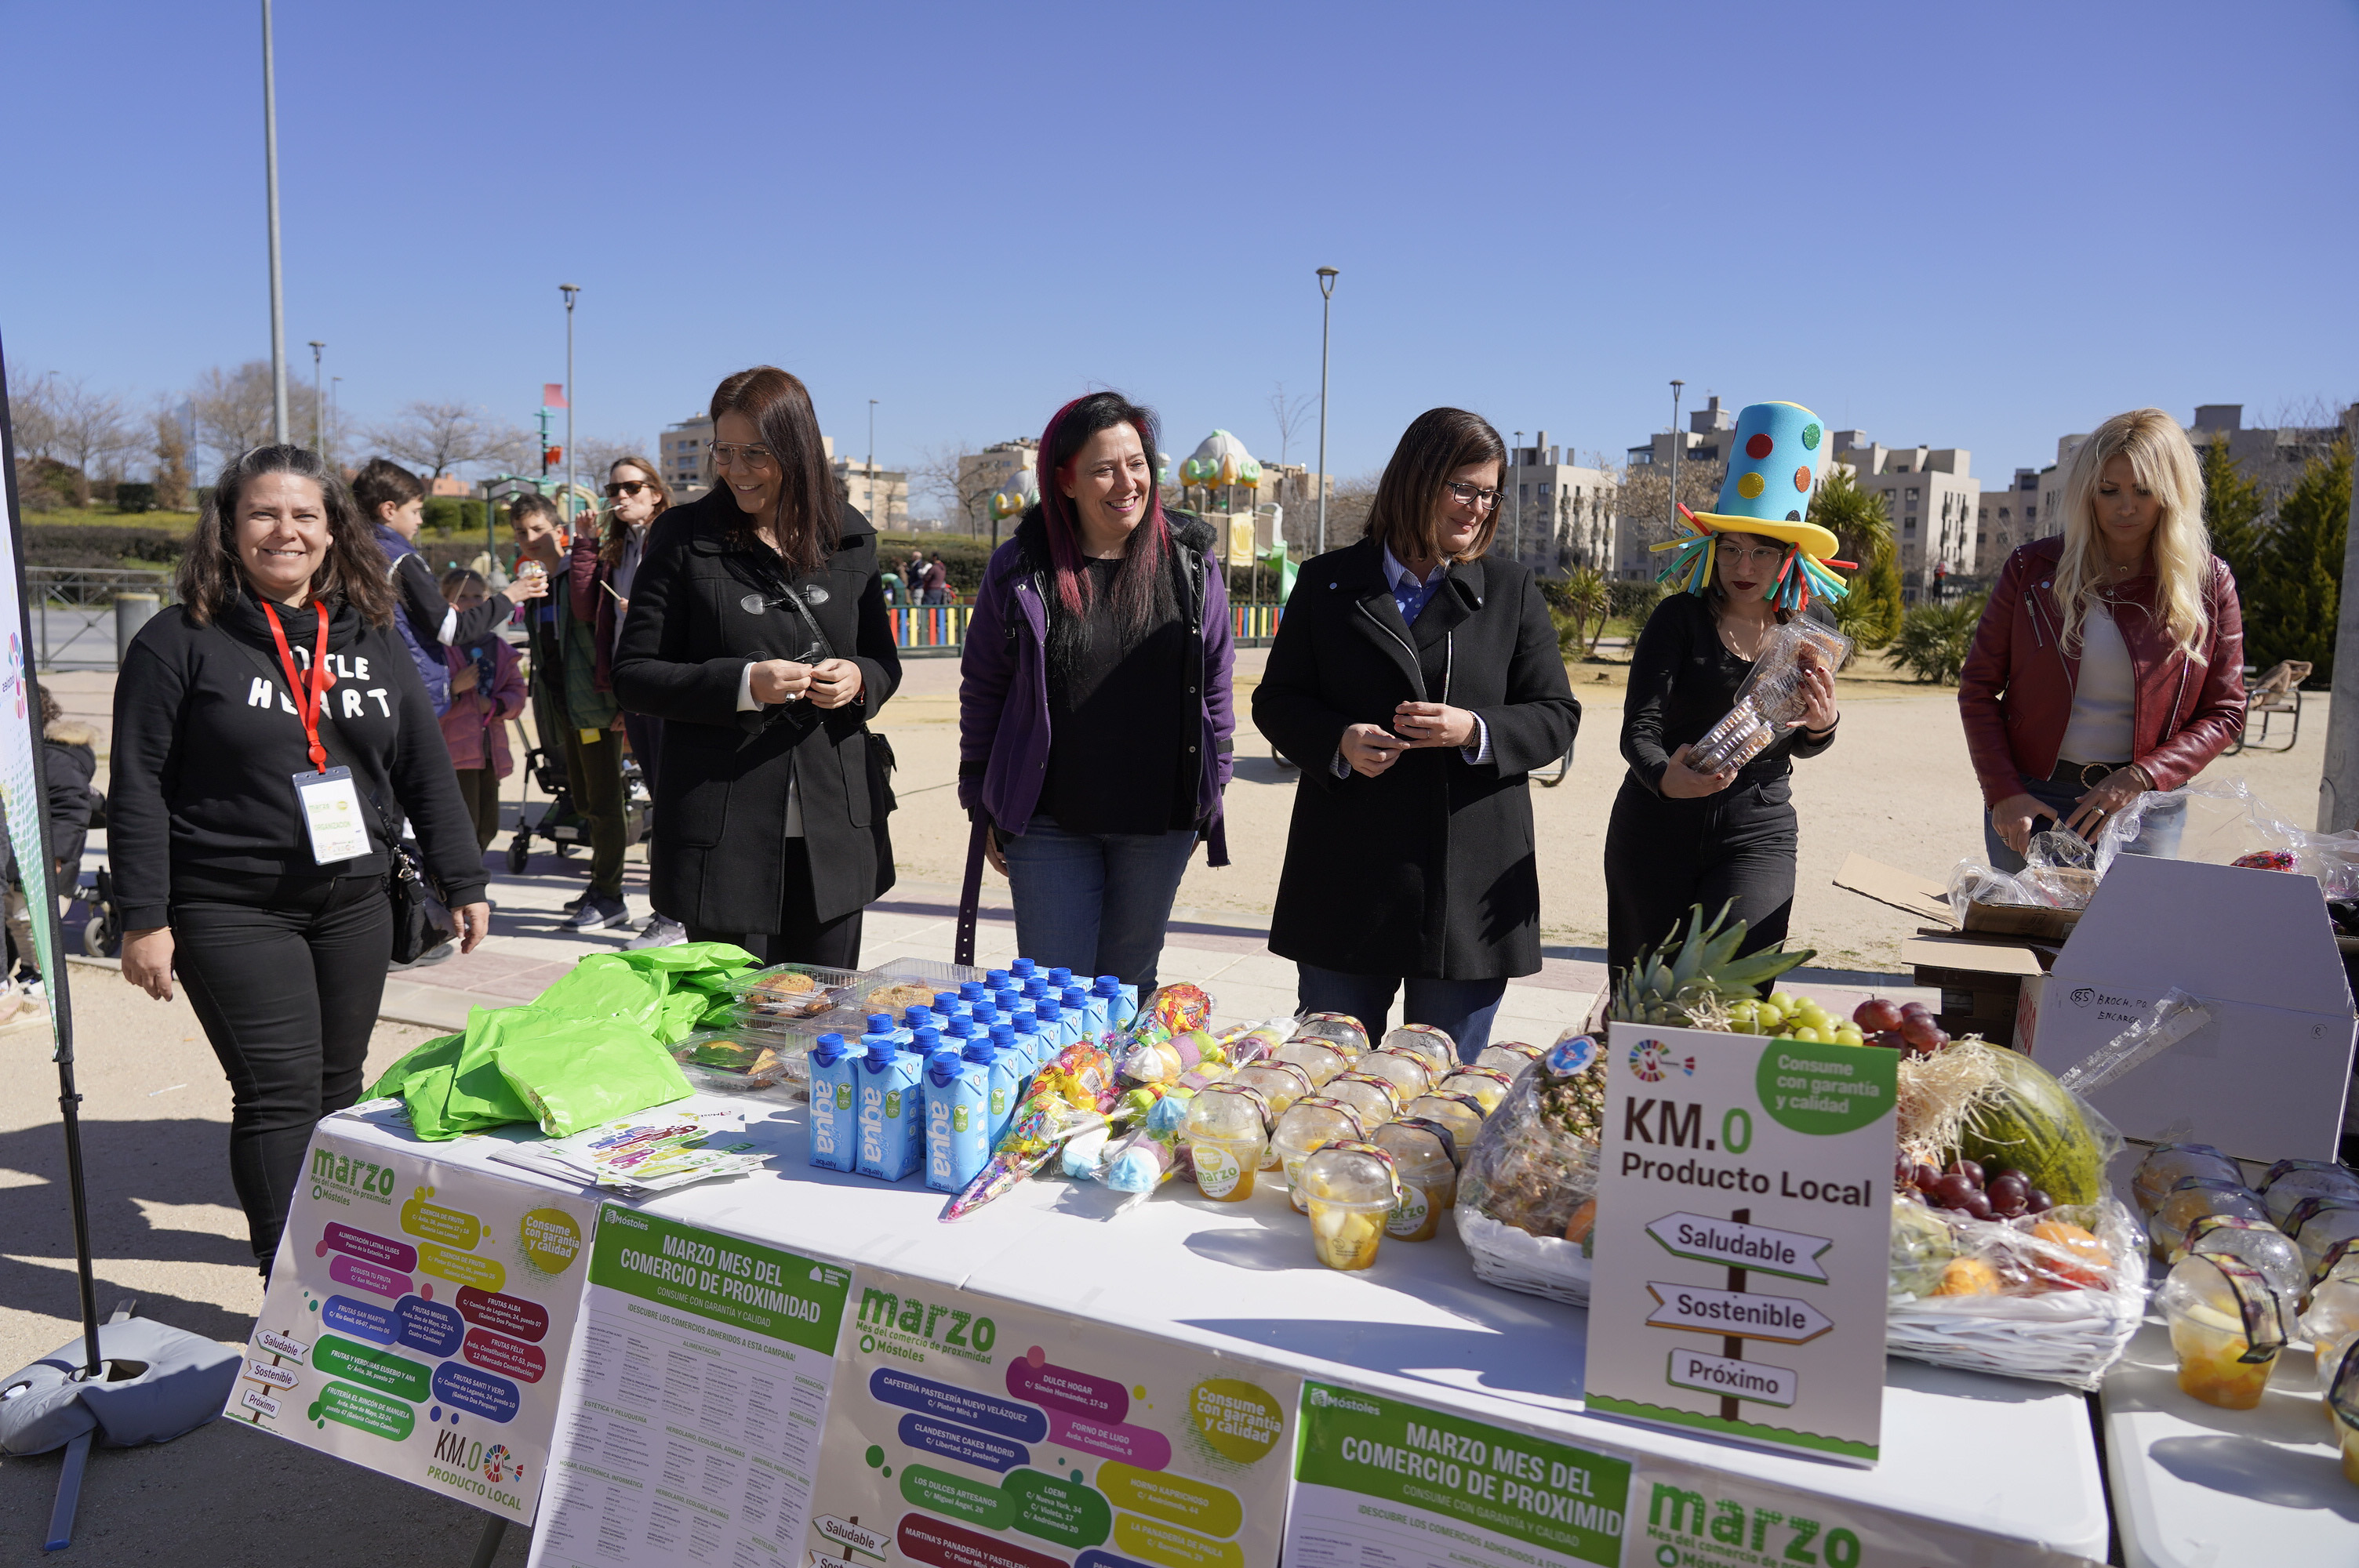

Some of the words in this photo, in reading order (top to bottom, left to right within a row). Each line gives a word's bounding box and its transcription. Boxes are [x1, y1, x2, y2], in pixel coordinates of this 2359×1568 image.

[2075, 992, 2090, 1003] 85
[1777, 1054, 1853, 1076] Consume
[1776, 1075, 1807, 1090] con
[1811, 1078, 1879, 1098] garantía
[1776, 1095, 1784, 1111] y
[1790, 1094, 1849, 1114] calidad
[811, 1080, 834, 1155] aqua
[860, 1087, 881, 1163] aqua
[927, 1101, 951, 1178] aqua
[312, 1148, 395, 1196] marzo
[816, 1158, 837, 1168] aqualy
[863, 1167, 884, 1178] aqualy
[1197, 1167, 1237, 1181] marzo
[309, 1174, 321, 1184] Mes
[320, 1178, 330, 1186] del
[329, 1181, 353, 1193] comercio
[351, 1188, 360, 1196] de
[359, 1190, 392, 1206] proximidad
[932, 1181, 954, 1192] aqualy
[1621, 1151, 1770, 1194] Producto
[1781, 1171, 1872, 1207] Local
[321, 1189, 352, 1206] Móstoles
[614, 1214, 649, 1231] Móstoles
[1387, 1203, 1427, 1218] arzo
[525, 1214, 571, 1237] Consume
[337, 1231, 370, 1246] ALIMENTACIÓN
[369, 1240, 384, 1250] LATINA
[383, 1245, 400, 1255] ULISES
[524, 1226, 541, 1239] con
[541, 1229, 581, 1250] garantía
[528, 1238, 536, 1250] y
[536, 1238, 572, 1258] calidad
[1677, 1223, 1796, 1264] Saludable
[663, 1235, 716, 1267] MARZO
[717, 1250, 753, 1278] MES
[754, 1259, 786, 1287] DEL
[620, 1248, 697, 1286] COMERCIO
[697, 1269, 722, 1294] DE
[723, 1279, 821, 1323] PROXIMIDAD
[337, 1305, 357, 1316] FRUTAS
[356, 1310, 367, 1319] SAN
[365, 1312, 387, 1324] MARTÍN
[412, 1305, 431, 1316] FRUTAS
[430, 1311, 449, 1322] MIGUEL
[487, 1298, 507, 1308] FRUTAS
[507, 1303, 522, 1312] ALBA
[656, 1286, 689, 1303] CONSUME
[689, 1295, 704, 1308] CON
[703, 1298, 737, 1317] GARANTÍA
[736, 1310, 742, 1319] Y
[741, 1311, 772, 1327] CALIDAD
[1677, 1294, 1806, 1330] Sostenible
[860, 1287, 996, 1352] marzo
[626, 1302, 660, 1319] ¡DESCUBRE
[658, 1312, 671, 1323] LOS
[670, 1316, 707, 1334] COMERCIOS
[705, 1327, 741, 1345] ADHERIDOS
[747, 1340, 762, 1351] ESTA
[762, 1344, 797, 1362] CAMPAÑA!
[855, 1320, 873, 1334] Mes
[873, 1325, 888, 1338] del
[889, 1329, 928, 1348] comercio
[929, 1340, 940, 1351] de
[941, 1342, 992, 1366] proximidad
[262, 1334, 300, 1356] Saludable
[490, 1338, 511, 1350] FRUTAS
[510, 1343, 525, 1355] FÉLIX
[682, 1339, 722, 1357] ALIMENTACIÓN
[876, 1339, 925, 1363] Móstoles
[253, 1363, 293, 1386] Sostenible
[479, 1354, 503, 1367] (Mercado
[502, 1362, 534, 1378] Constitución)
[1688, 1359, 1779, 1394] Próximo
[794, 1375, 825, 1392] FORMACIÓN
[1042, 1374, 1066, 1387] DULCE
[1067, 1381, 1092, 1395] HOGAR
[248, 1393, 277, 1413] Próximo
[326, 1385, 351, 1400] FRUTERÍA
[351, 1394, 358, 1403] EL
[357, 1395, 379, 1409] RINCÓN
[377, 1403, 386, 1412] DE
[385, 1405, 409, 1420] MANUELA
[883, 1375, 920, 1393] CAFETERÍA
[920, 1385, 961, 1405] PASTELERÍA
[961, 1398, 986, 1411] NUEVO
[986, 1403, 1027, 1423] VELÁZQUEZ
[1197, 1385, 1267, 1417] Consume
[1328, 1396, 1380, 1416] Móstoles
[583, 1399, 610, 1412] ESTÉTICA
[613, 1408, 648, 1424] PELUQUERÍA
[787, 1410, 818, 1428] MOBILIARIO
[1196, 1400, 1221, 1417] con
[1223, 1403, 1282, 1435] garantía
[664, 1425, 698, 1442] HERBOLARIO,
[696, 1436, 724, 1450] ECOLOGÍA,
[723, 1445, 746, 1458] AROMAS
[914, 1423, 961, 1443] CLANDESTINE
[961, 1436, 985, 1450] CAKES
[985, 1443, 1015, 1458] MADRID
[1071, 1421, 1097, 1435] FORNO
[1097, 1428, 1108, 1438] DE
[1109, 1432, 1130, 1444] LUGO
[1203, 1416, 1214, 1432] y
[1216, 1417, 1270, 1444] calidad
[1342, 1436, 1461, 1488] COMERCIO
[1467, 1469, 1497, 1501] DE
[1407, 1421, 1486, 1465] MARZO
[1493, 1446, 1545, 1483] MES
[1550, 1461, 1594, 1497] DEL
[427, 1465, 486, 1496] PRODUCTO
[488, 1487, 522, 1511] LOCAL
[914, 1476, 928, 1486] LOS
[928, 1480, 956, 1495] DULCES
[955, 1489, 998, 1508] ARTESANOS
[1043, 1486, 1067, 1500] LOEMI
[1129, 1477, 1158, 1492] HORNO
[1158, 1486, 1209, 1508] KAPRICHOSO
[1403, 1483, 1451, 1507] CONSUME
[1454, 1499, 1474, 1512] CON
[1476, 1506, 1525, 1530] GARANTÍA
[1527, 1523, 1534, 1533] Y
[1536, 1524, 1579, 1548] CALIDAD
[1649, 1483, 1860, 1568] marzo
[750, 1535, 780, 1554] HOSTELERÍA
[826, 1521, 874, 1549] Saludable
[1647, 1526, 1672, 1543] Mes
[1675, 1531, 1696, 1549] del
[1699, 1540, 1758, 1563] comercio
